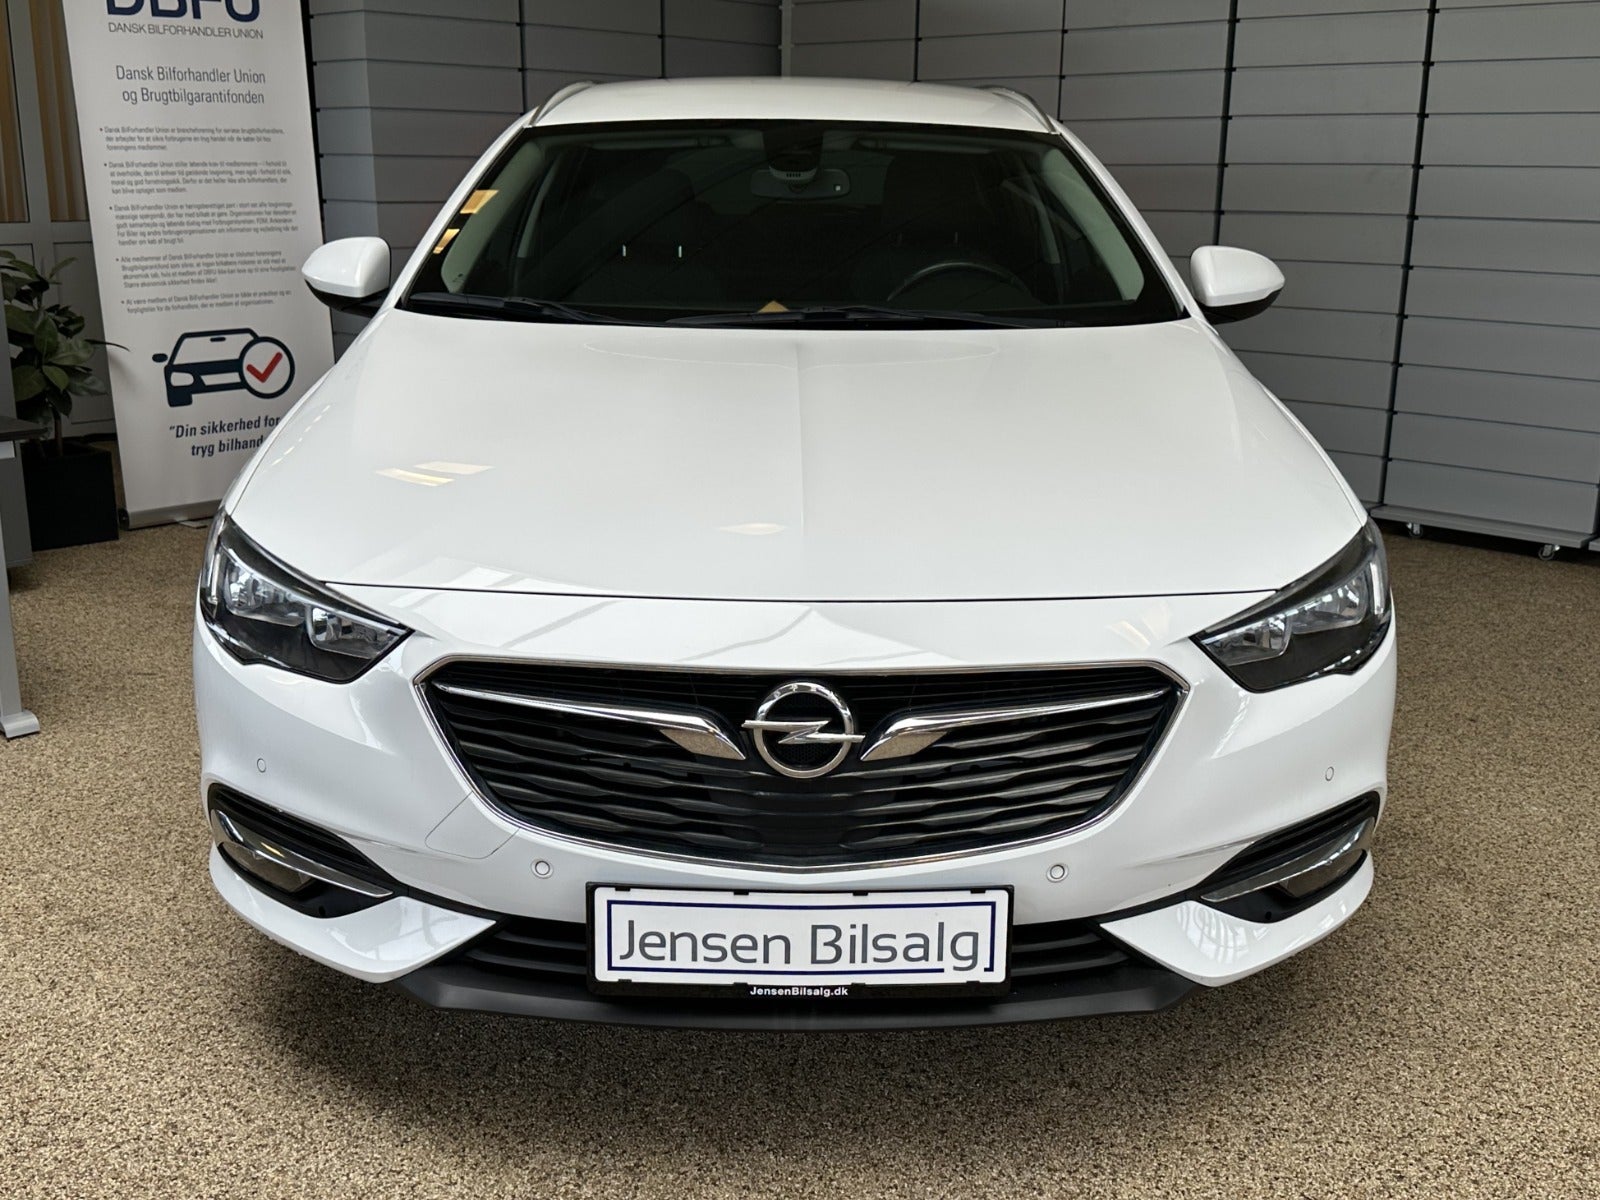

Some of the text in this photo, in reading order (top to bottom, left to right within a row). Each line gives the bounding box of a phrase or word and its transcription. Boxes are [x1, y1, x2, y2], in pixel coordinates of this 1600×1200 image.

[108, 21, 264, 40] DANSK BILFORHANDLER UNION
[115, 65, 266, 84] Dansk Bilforhandler Union
[122, 87, 265, 106] og Brugtbilgarantifonden
[200, 416, 261, 436] sikkerhed
[264, 415, 281, 428] for
[191, 444, 215, 458] tryg
[619, 920, 979, 972] Jensen Bilsalg
[749, 986, 850, 999] JensenBilsalg.dk
